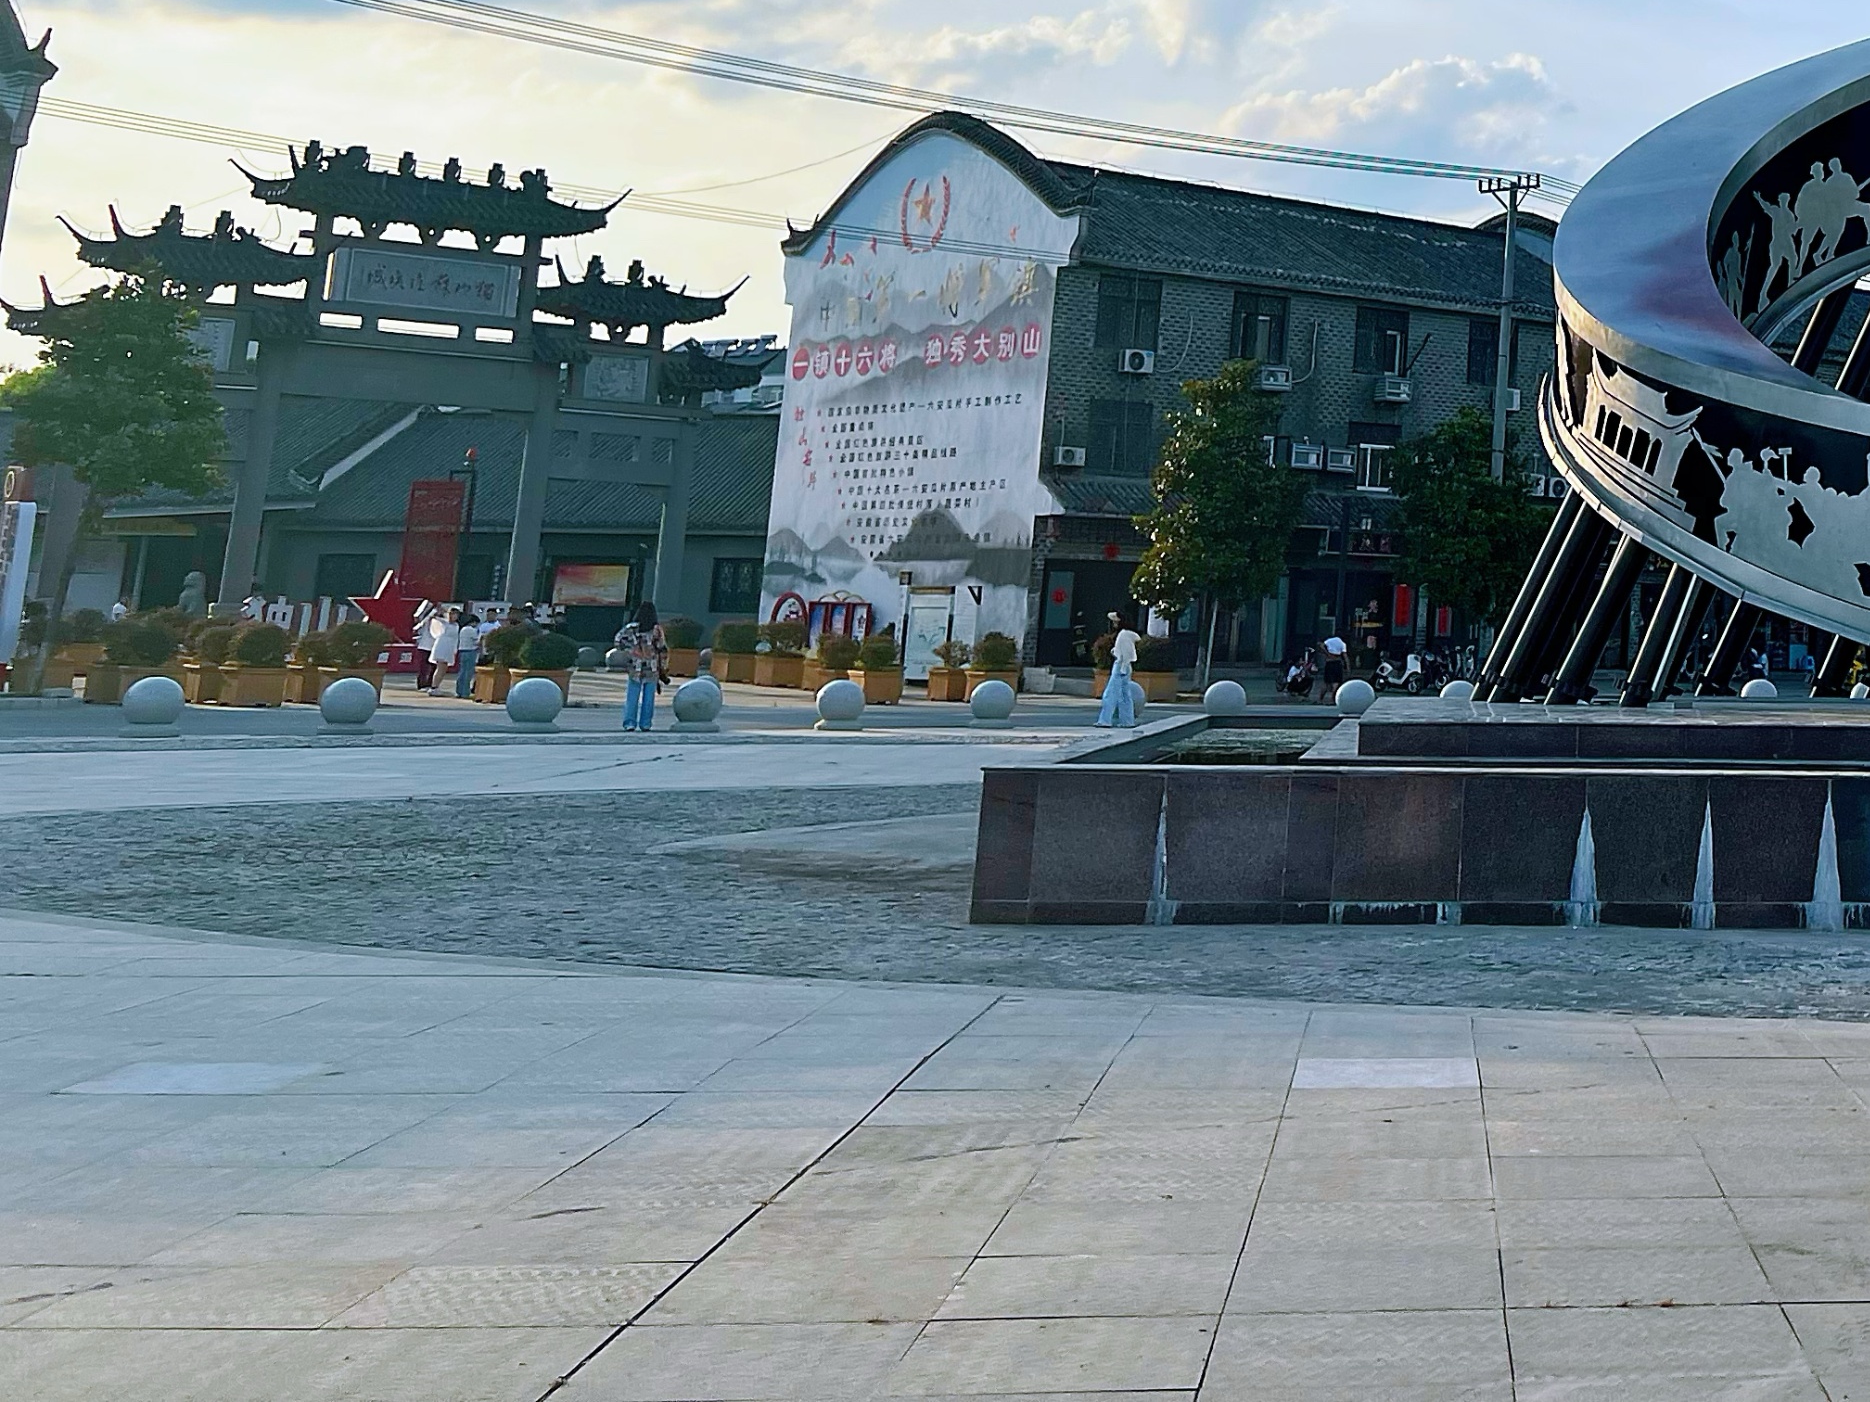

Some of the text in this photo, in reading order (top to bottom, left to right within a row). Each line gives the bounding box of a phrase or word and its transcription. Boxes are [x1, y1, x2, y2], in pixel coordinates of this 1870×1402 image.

[791, 325, 1042, 378] 一镇十六将 独秀大别山
